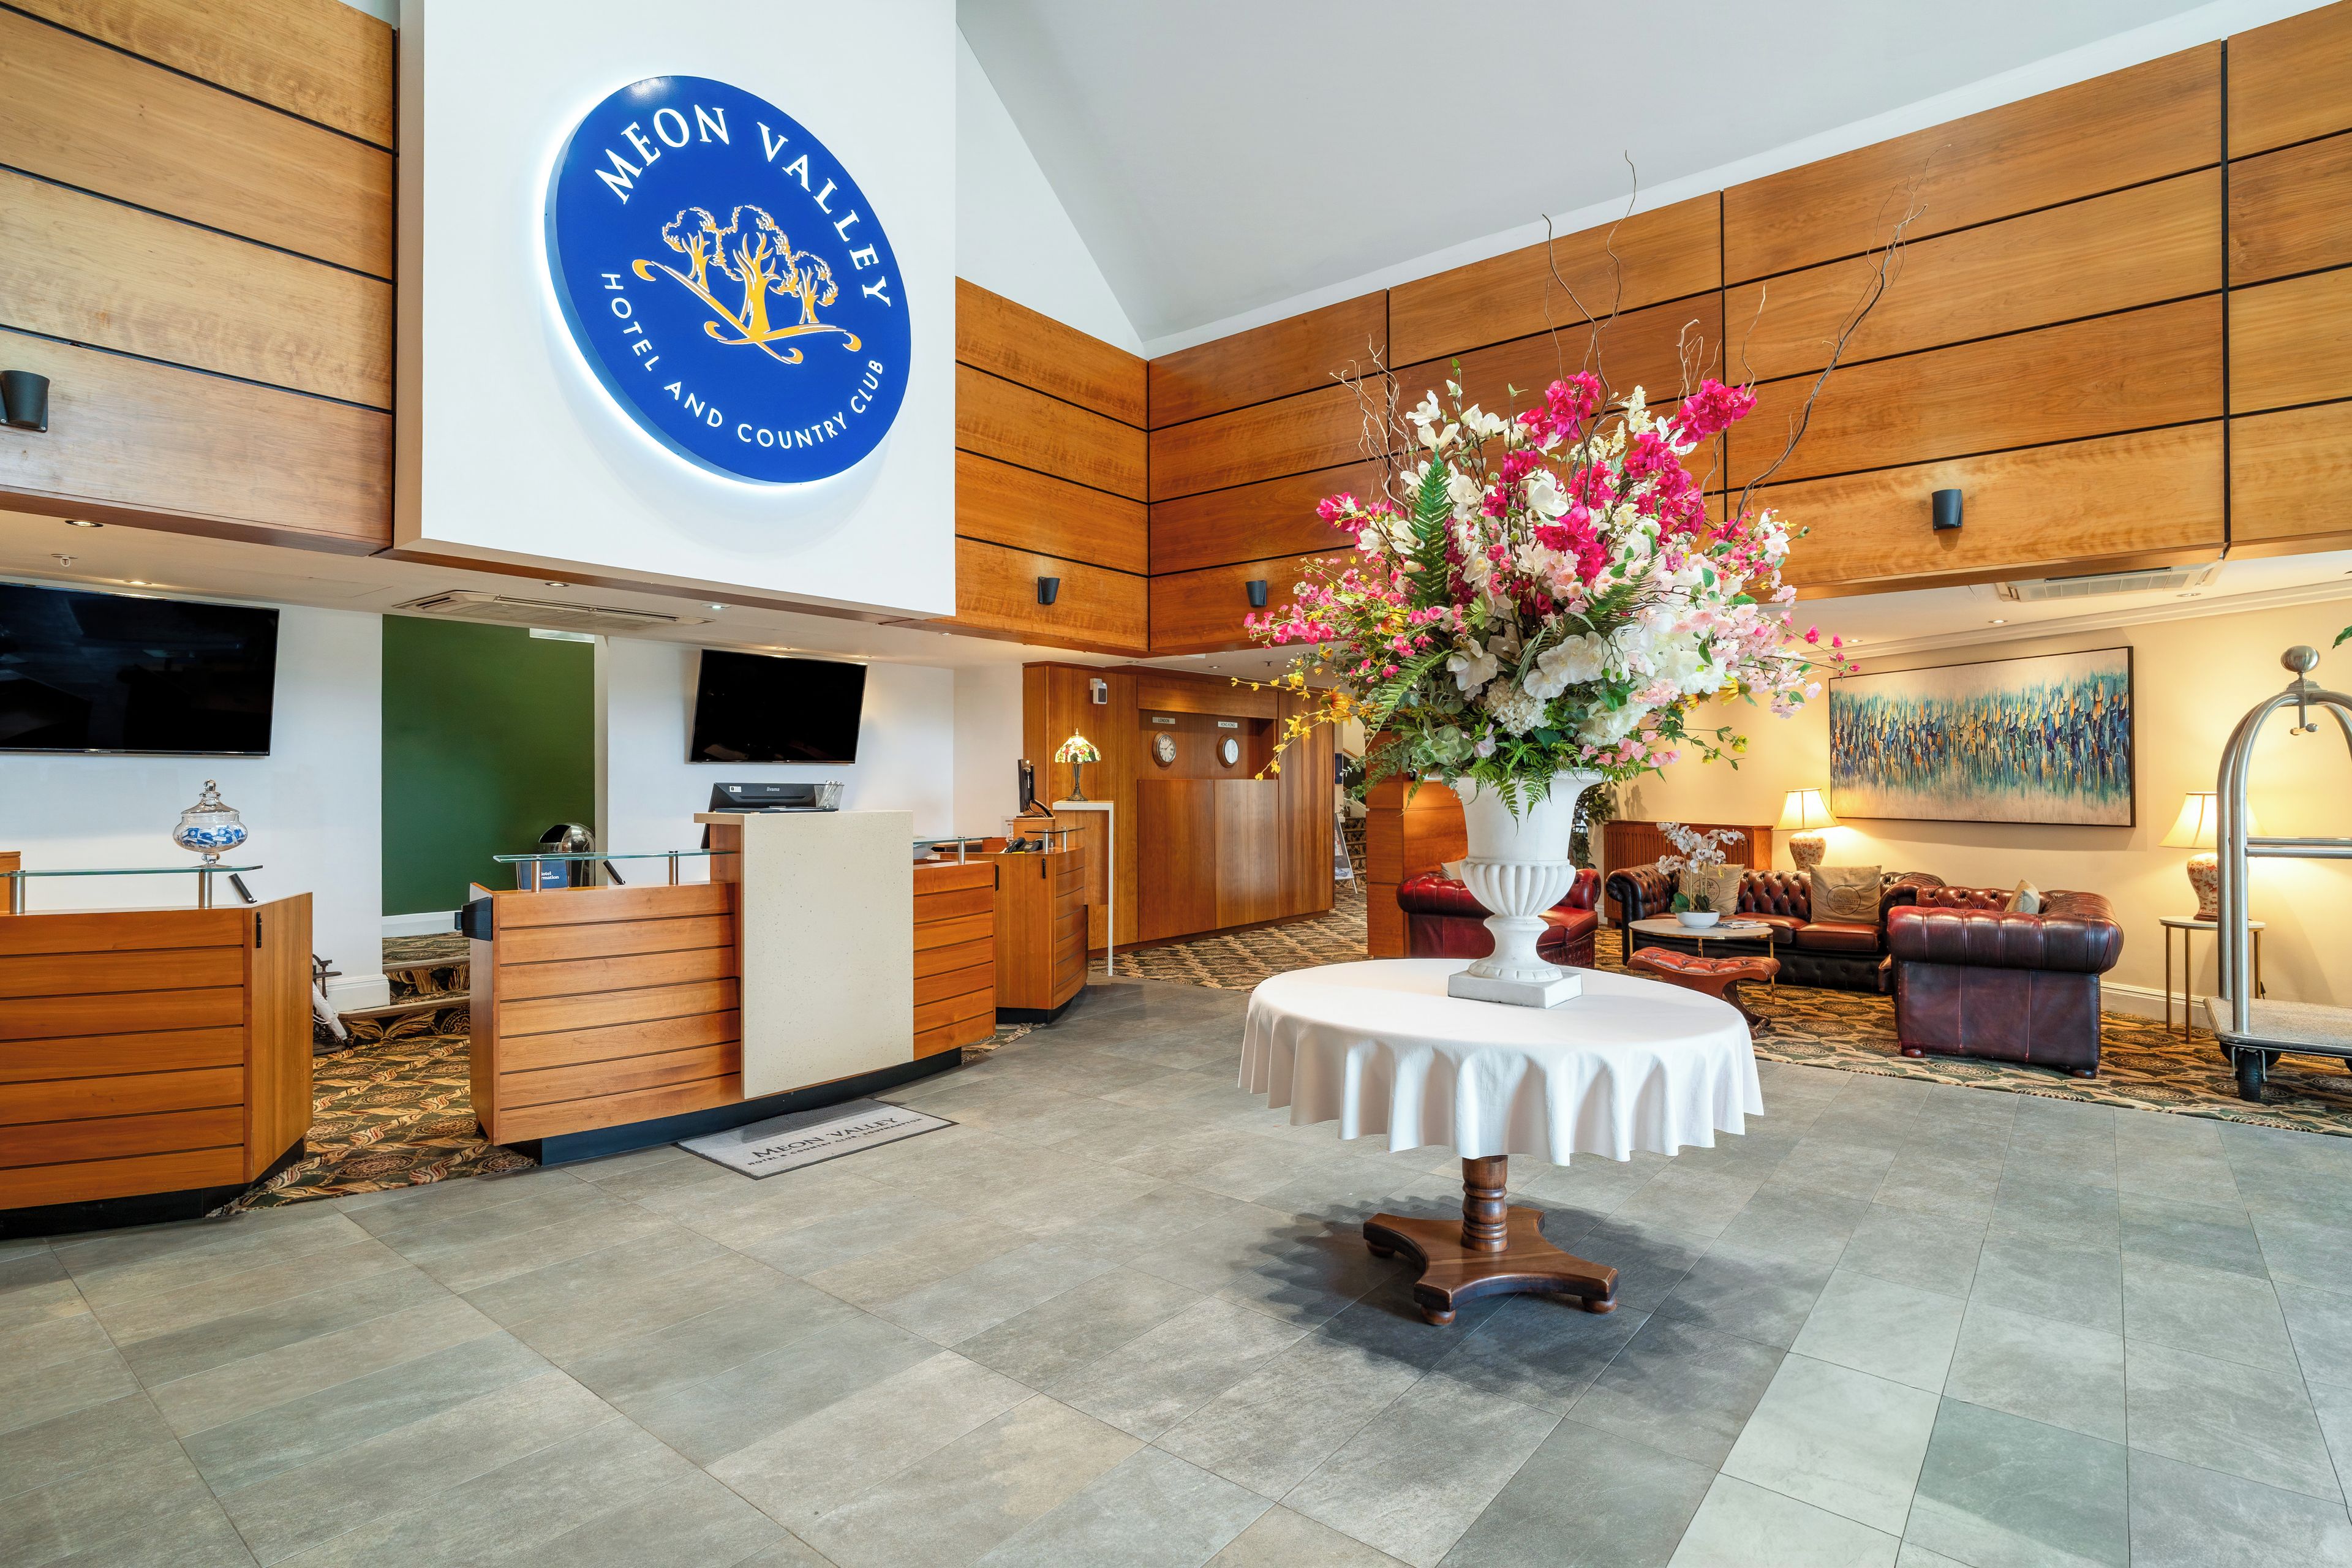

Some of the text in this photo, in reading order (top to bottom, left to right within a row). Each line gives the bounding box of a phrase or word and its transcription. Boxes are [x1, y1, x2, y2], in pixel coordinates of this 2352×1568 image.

[595, 104, 891, 307] MEON VALLEY
[601, 273, 883, 449] HOTEL AND COUNTRY CLUB
[747, 1156, 779, 1166] HOTEL
[790, 1142, 832, 1155] COUNTRY
[862, 1118, 923, 1136] SOUTHAMPTON
[752, 1117, 898, 1158] MEON VALLEY
